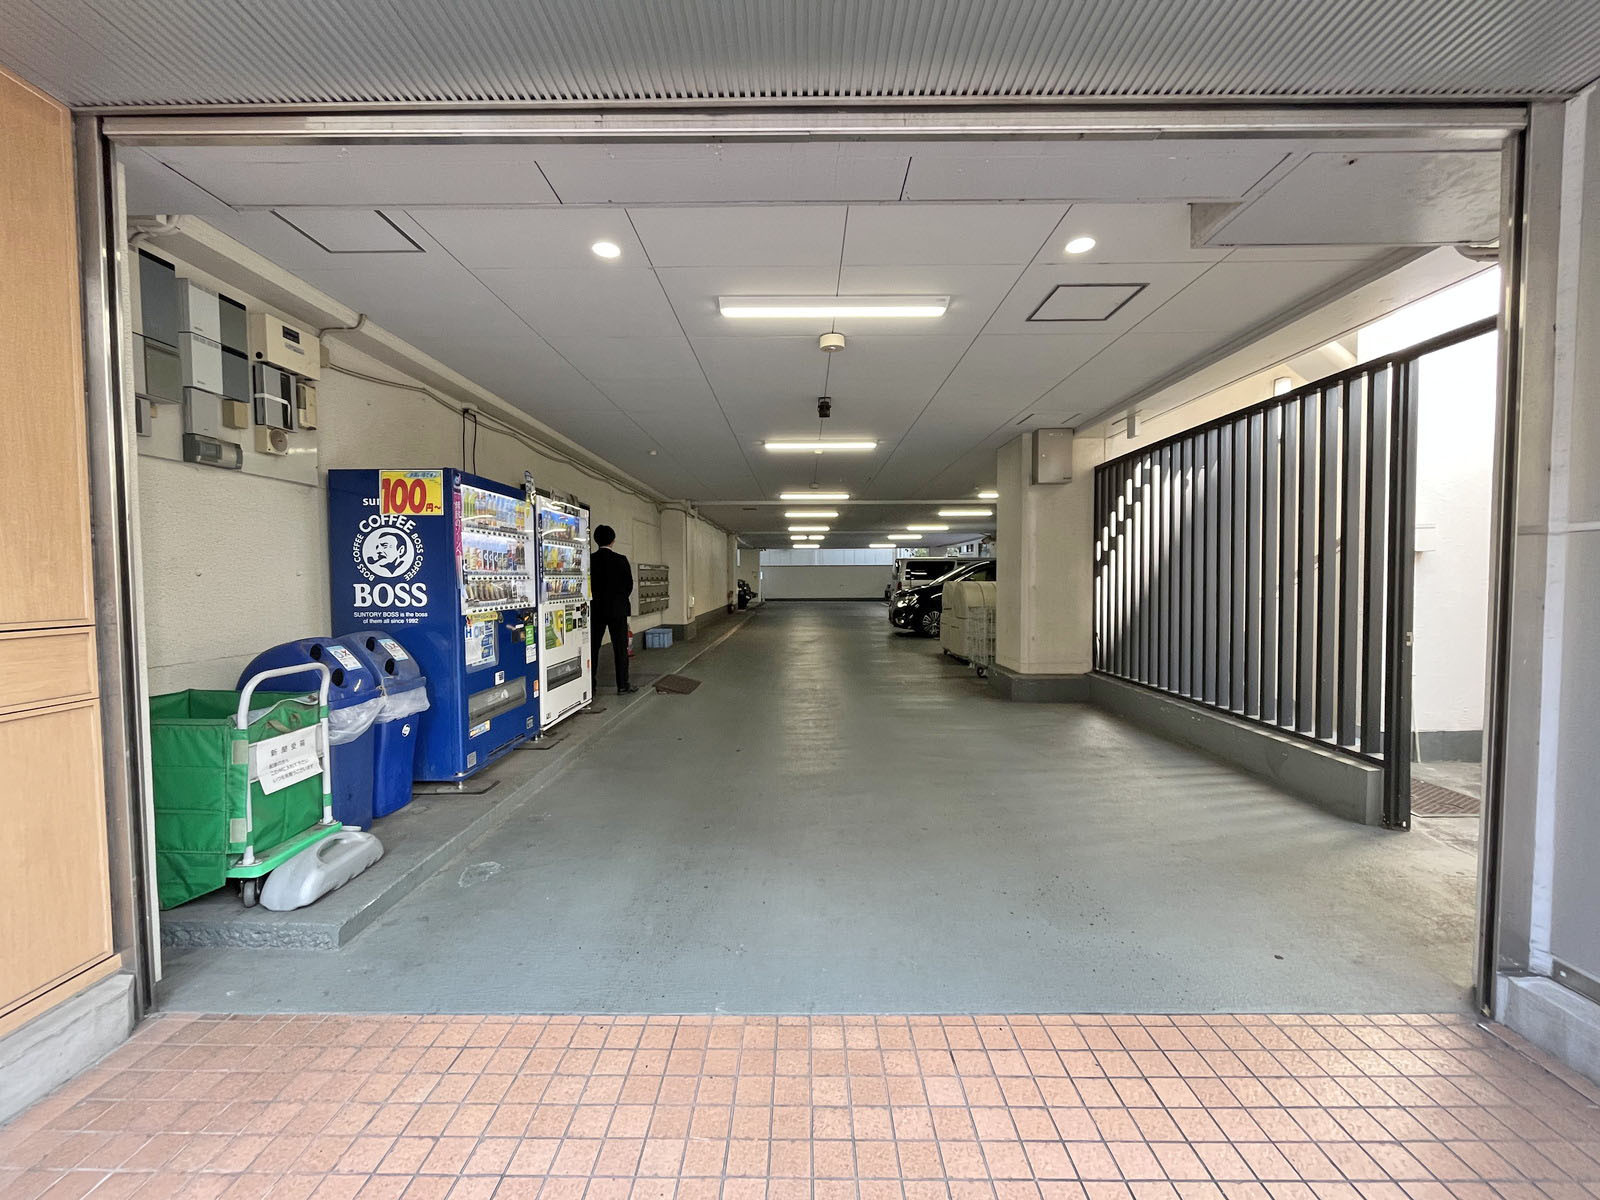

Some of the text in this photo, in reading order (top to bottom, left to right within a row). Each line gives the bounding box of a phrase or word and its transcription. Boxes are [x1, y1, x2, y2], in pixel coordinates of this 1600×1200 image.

[358, 514, 417, 533] COFFEE
[352, 533, 375, 582] BOSS COFFEE
[403, 532, 424, 582] BOSS COFFEE
[352, 582, 428, 608] BOSS
